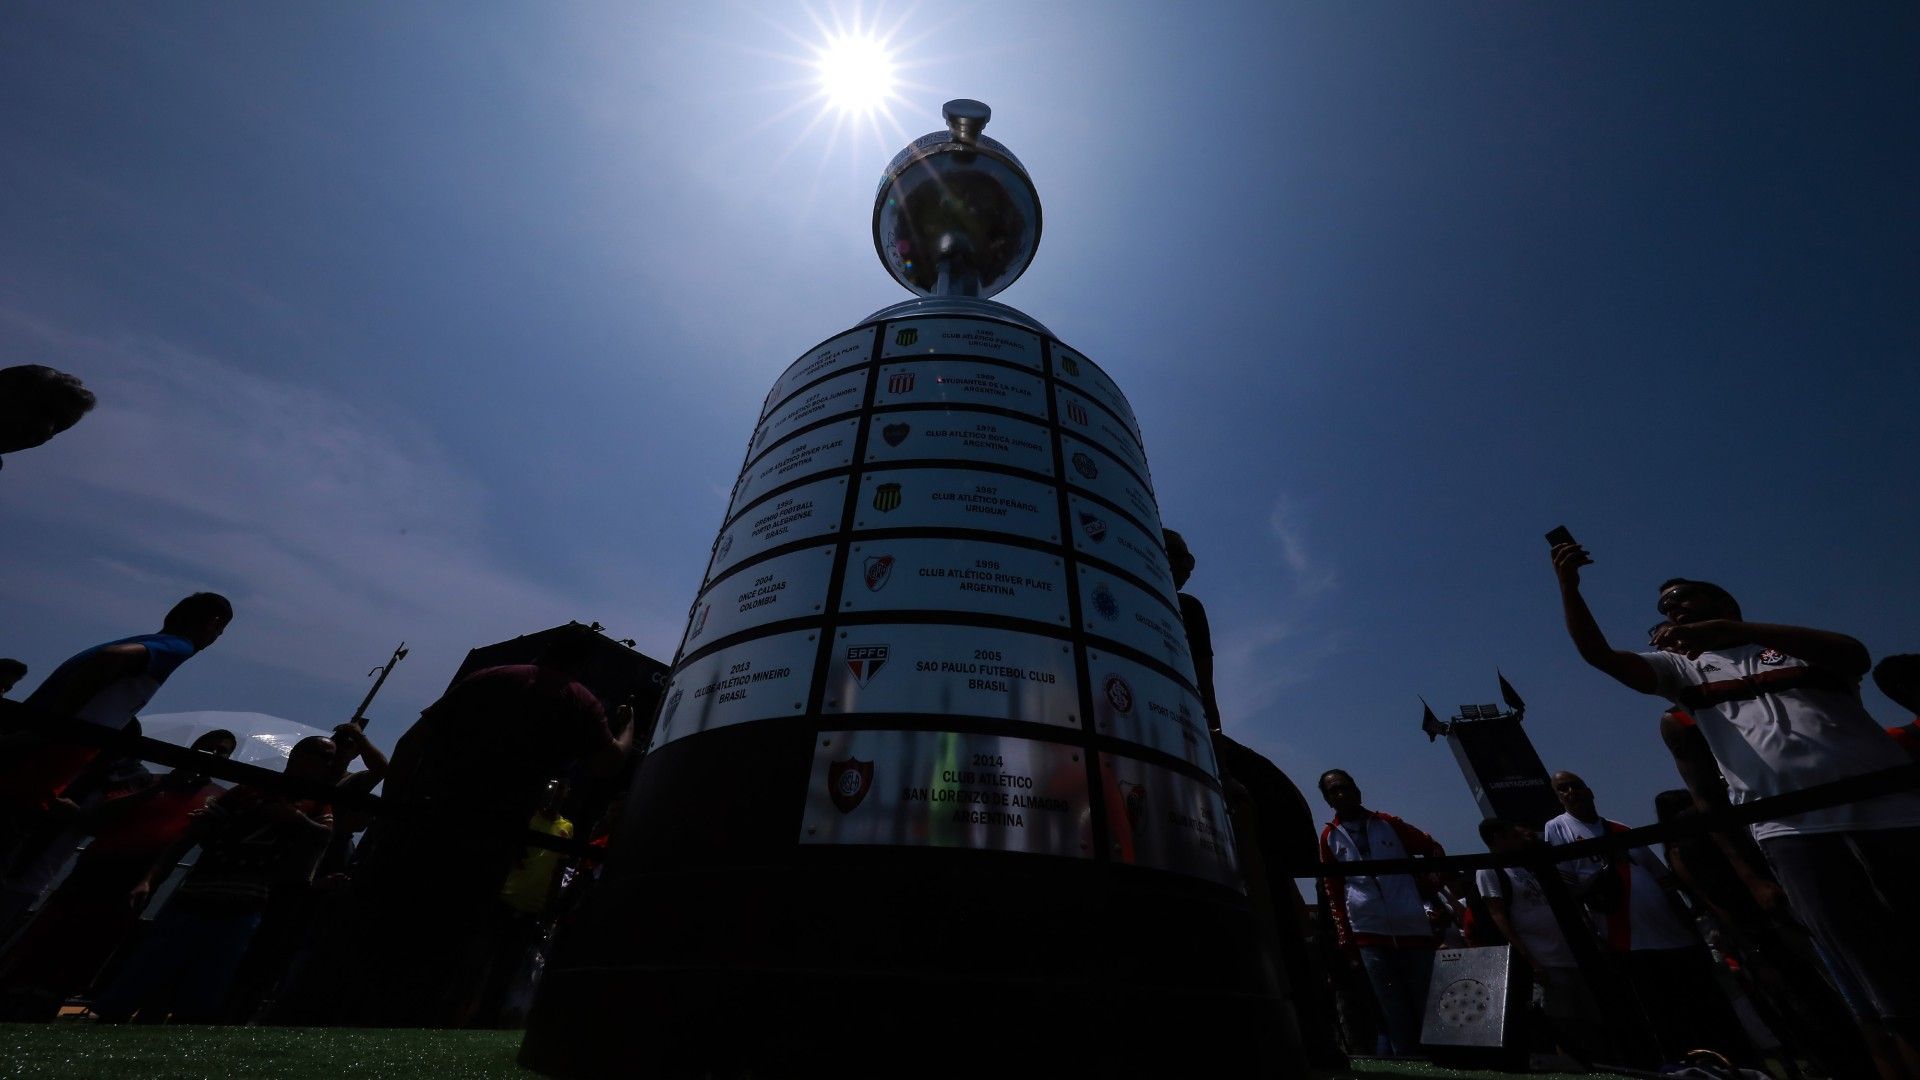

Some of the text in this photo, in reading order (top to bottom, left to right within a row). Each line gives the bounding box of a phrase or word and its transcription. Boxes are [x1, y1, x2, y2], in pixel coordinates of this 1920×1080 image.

[829, 387, 857, 400] JUNIORS
[964, 386, 1006, 396] ARGENTINA
[822, 440, 843, 451] PLATE
[963, 439, 1009, 451] ARGENTINA
[988, 434, 1010, 443] BOCA
[778, 456, 812, 475] ARGENTINA
[932, 492, 956, 500] CLUB
[779, 500, 813, 517] FOOTBALL
[965, 504, 1007, 516] URUGUAY
[752, 509, 813, 537] PORTO ALEGRENSE
[765, 526, 789, 540] BRASIL
[754, 575, 774, 587] 2004
[918, 567, 1053, 592] CLUB ATLÉTICO RIVER PLATE
[738, 581, 787, 603] ONCE CALDAS
[959, 582, 1015, 597] ARGENTINA
[739, 594, 777, 613] COLOMBIA
[849, 648, 886, 658] SPFC
[974, 650, 1002, 661] 2005
[730, 661, 751, 674] 2013
[752, 667, 791, 682] MINEIRO
[941, 662, 976, 674] PAULO
[979, 664, 1027, 680] FUTEBOL
[1028, 671, 1056, 684] CLUB
[968, 679, 1008, 692] BRASIL
[719, 688, 747, 704] BRASIL
[1148, 701, 1169, 718] SPORT
[973, 754, 1003, 768] 2014
[942, 770, 1033, 789] CLUB ATLÉTICO
[903, 787, 1069, 812] SAN LORENZO DE ALMAGRO
[952, 810, 1024, 828] ARGENTINA
